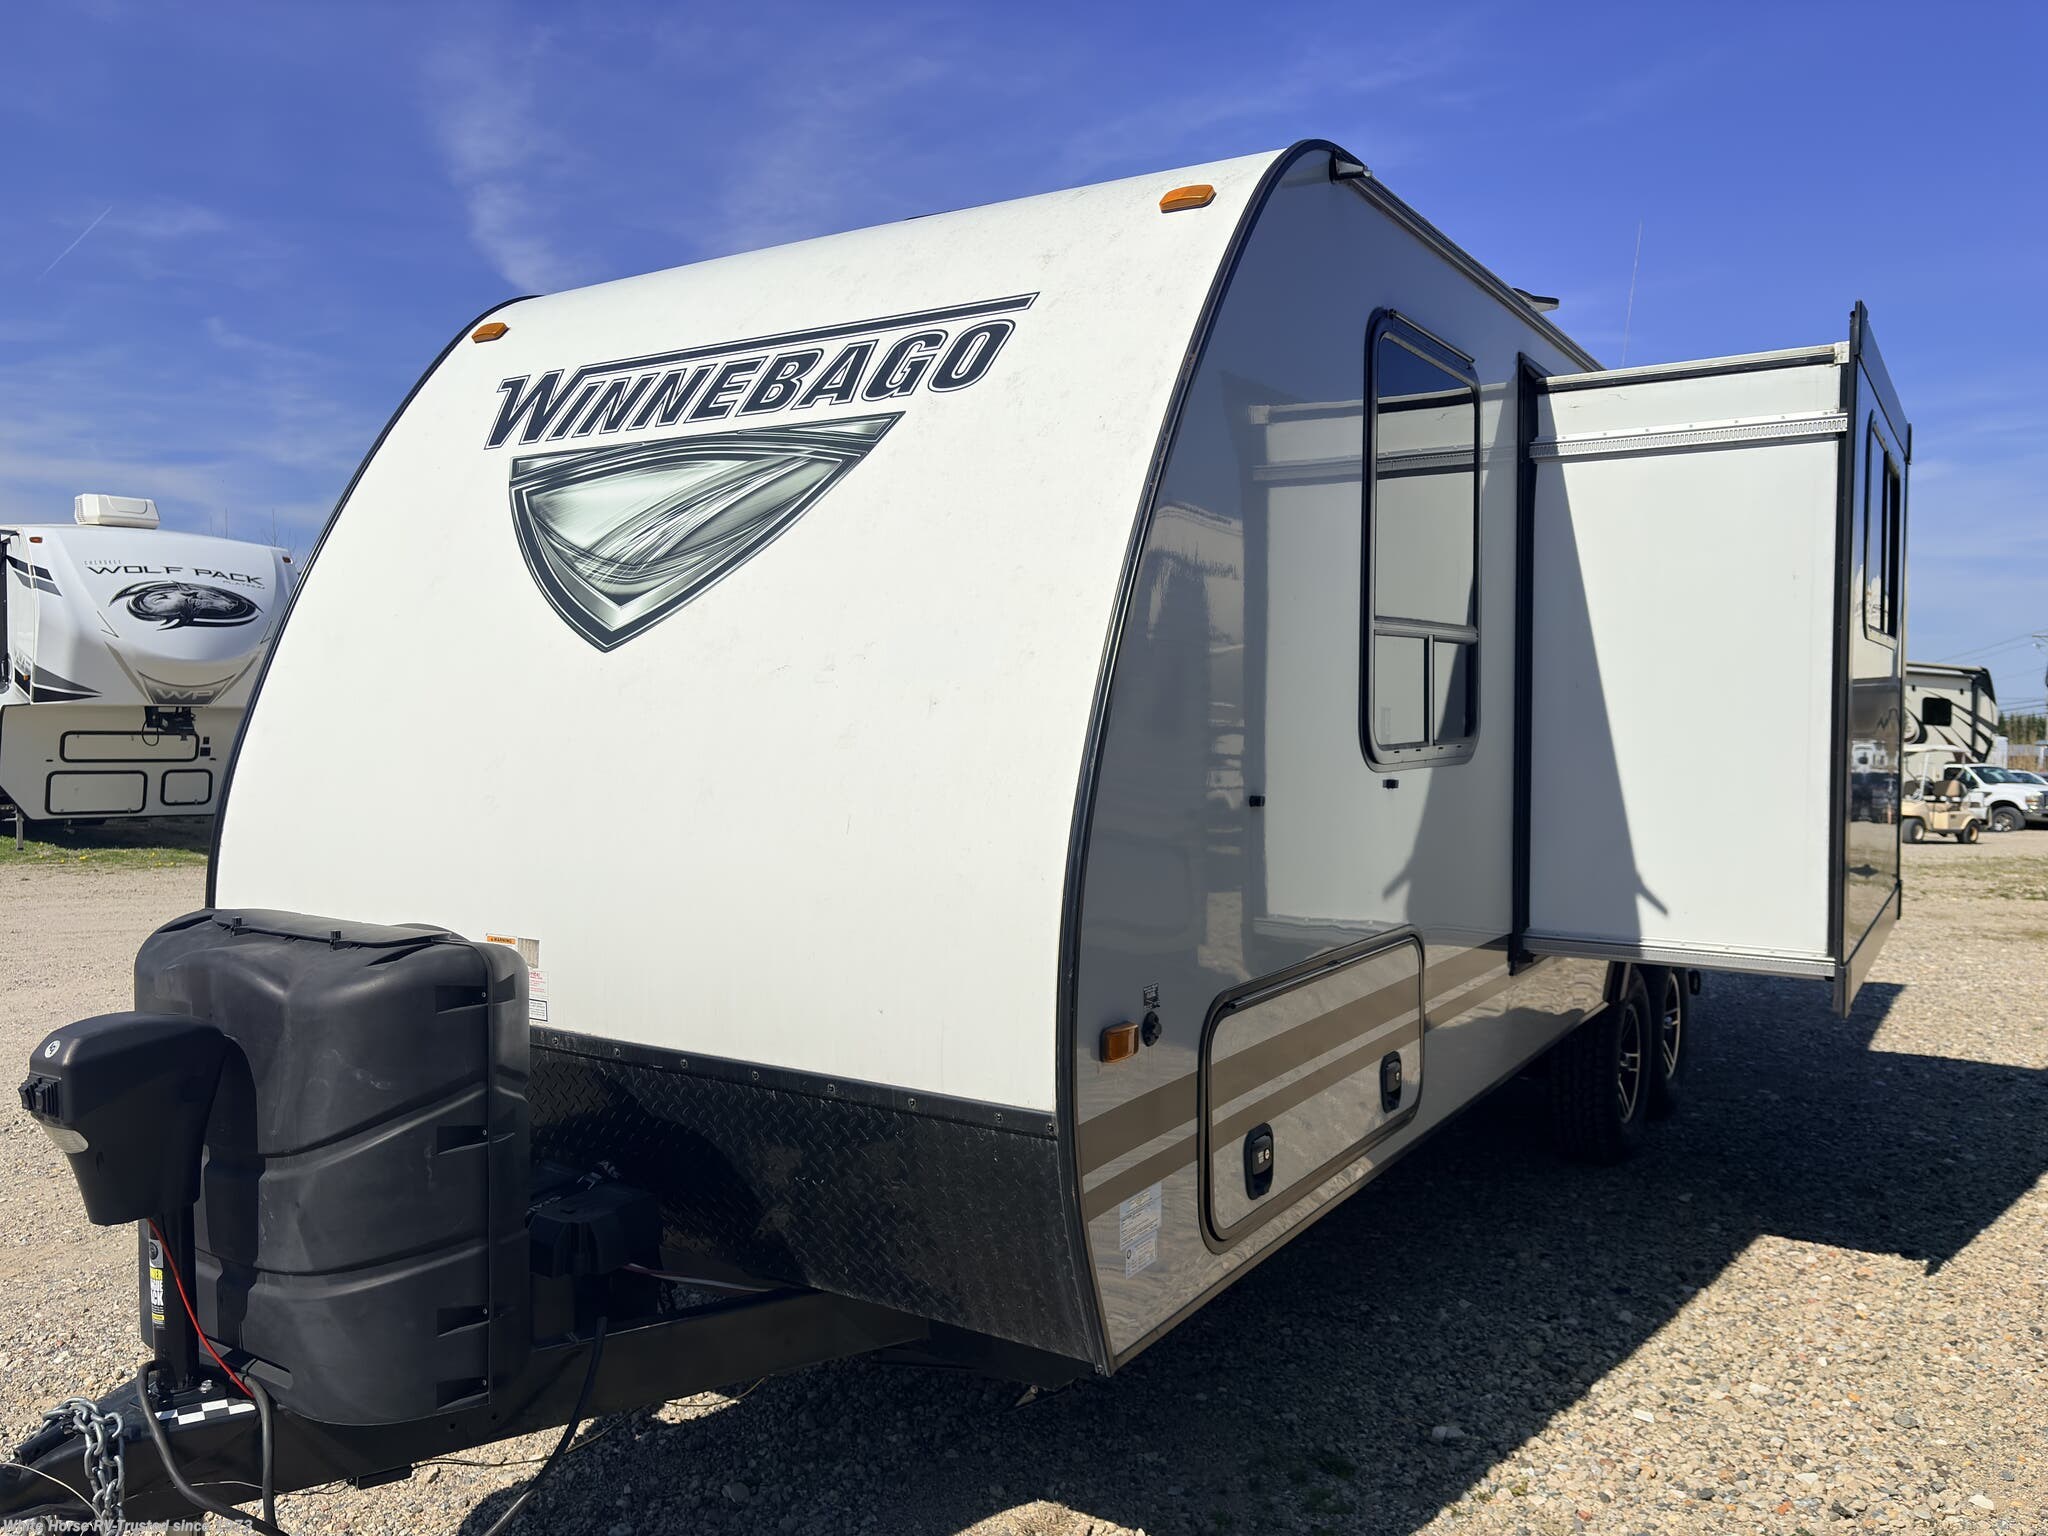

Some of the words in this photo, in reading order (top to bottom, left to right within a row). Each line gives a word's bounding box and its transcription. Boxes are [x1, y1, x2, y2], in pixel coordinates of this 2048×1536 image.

[484, 318, 1016, 450] WINNEBAGO
[87, 565, 184, 575] WOLF
[193, 567, 266, 586] PACK
